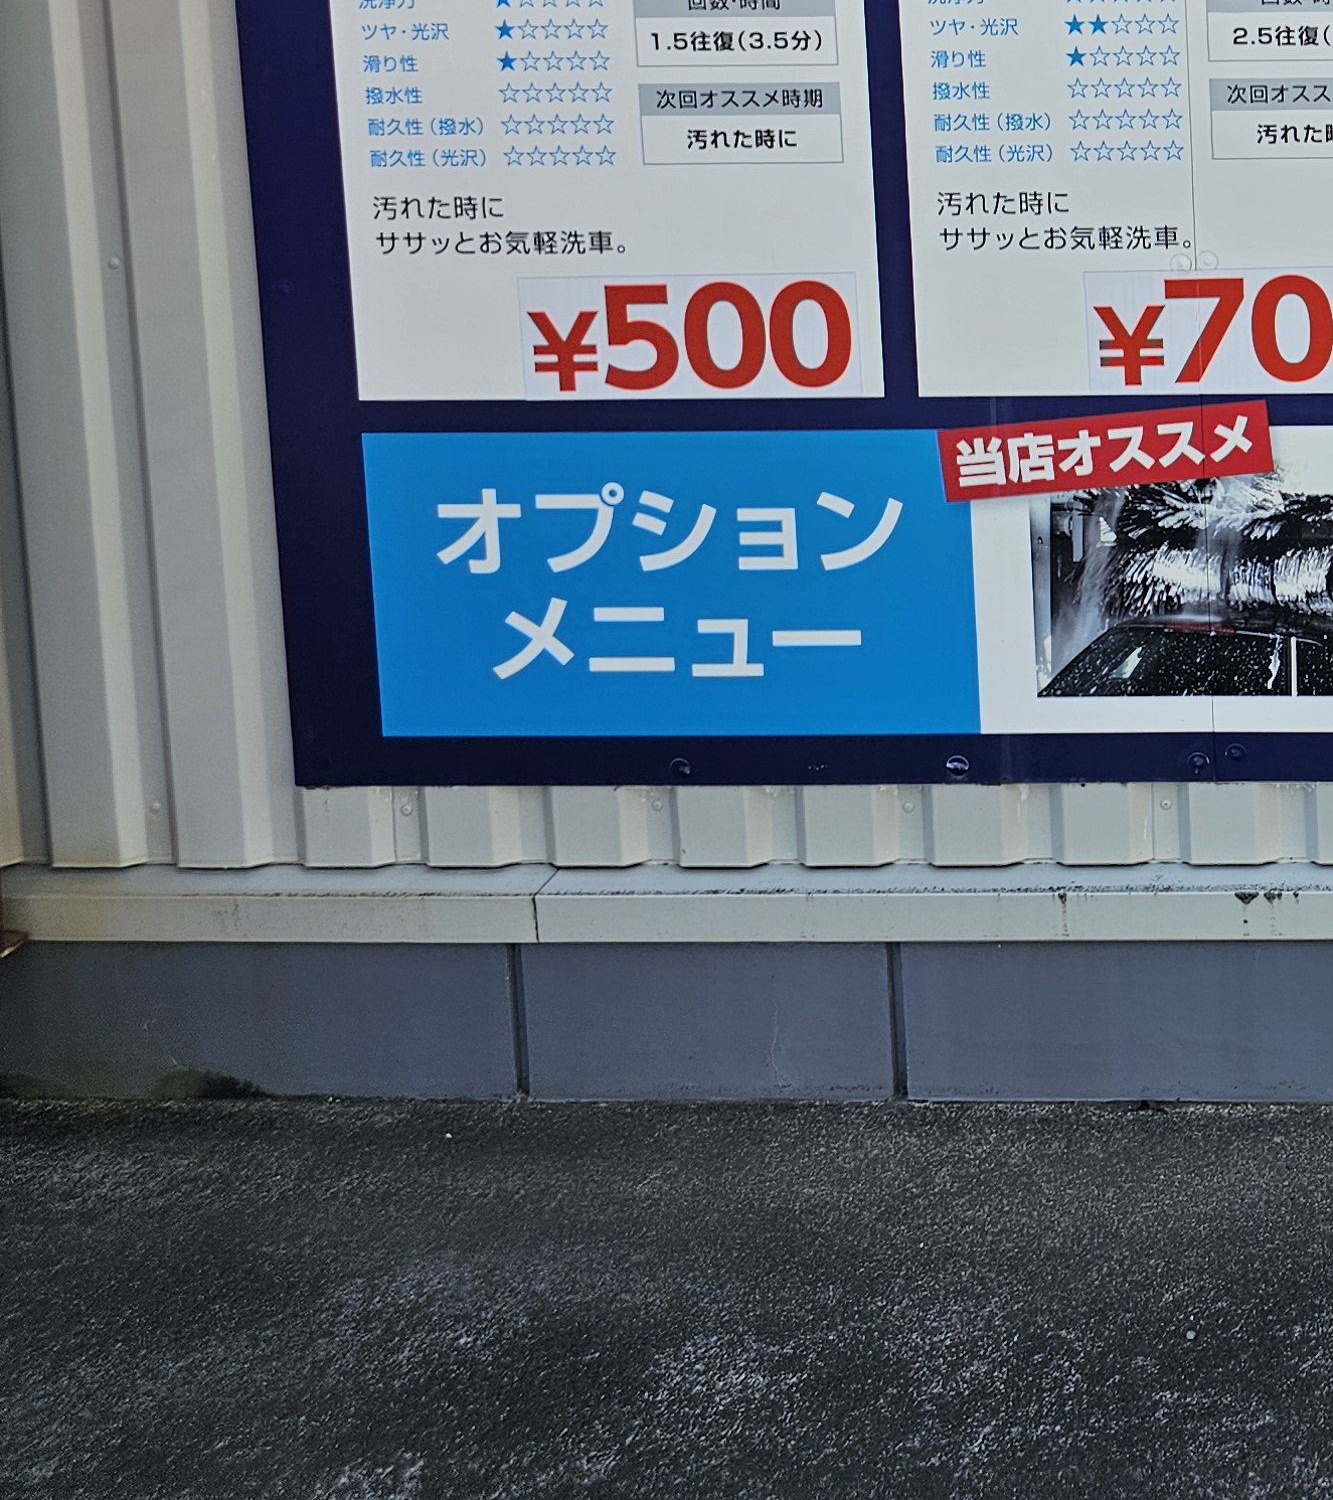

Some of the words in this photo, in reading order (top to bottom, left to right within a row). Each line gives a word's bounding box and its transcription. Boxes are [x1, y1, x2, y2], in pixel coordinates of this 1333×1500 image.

[362, 54, 419, 74] 滑り性
[930, 49, 987, 69] 滑り性
[365, 86, 423, 105] 撥水性
[656, 88, 823, 110] 次回オススメ時期
[932, 81, 991, 101] 撥水性
[686, 128, 798, 150] 汚れた時に
[373, 195, 504, 221] 汚れた時に
[937, 190, 1069, 216] 汚れた時に
[375, 230, 626, 255] ササッとお気軽洗車。
[939, 225, 1193, 252] ササッとお気軽洗車。
[526, 279, 852, 392] ¥500
[955, 413, 1255, 489] 当店オススメ
[436, 481, 904, 574] オプション
[492, 597, 862, 680] メニュー
